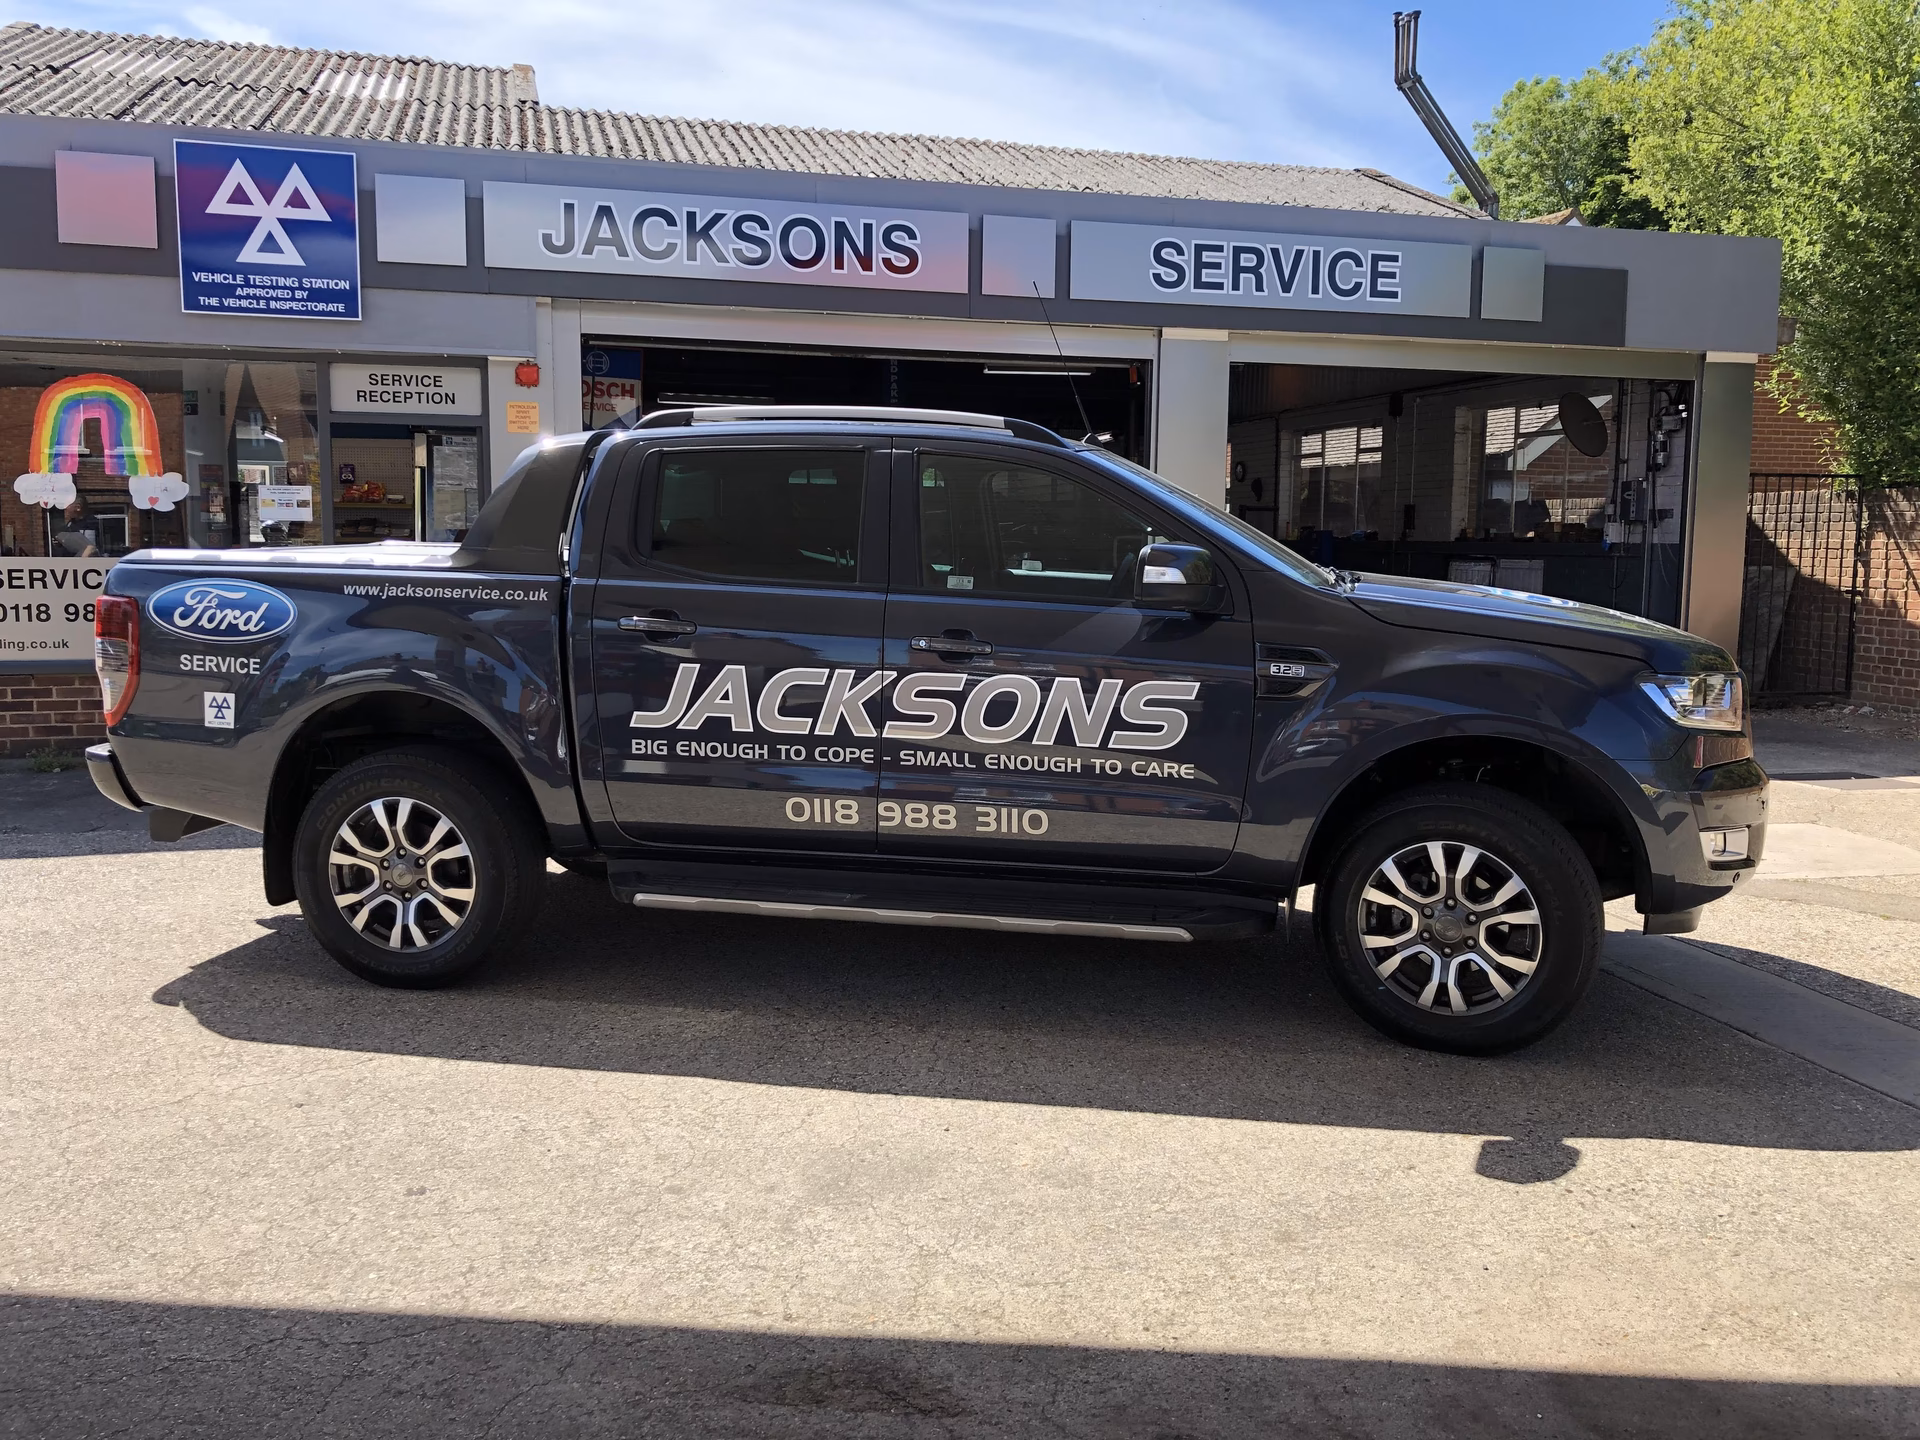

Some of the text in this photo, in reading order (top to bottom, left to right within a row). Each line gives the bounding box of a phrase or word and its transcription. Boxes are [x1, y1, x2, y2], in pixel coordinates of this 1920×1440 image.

[538, 198, 1402, 302] JACKSONS SERVICE
[192, 271, 350, 290] VEHICLE TESTING STATION
[235, 287, 308, 299] APPROVED BY
[198, 296, 346, 313] THE VEHICLE INSPECTORATE
[368, 373, 443, 388] SERVICE
[582, 380, 635, 401] OSCH
[356, 390, 456, 405] RECEPTION
[583, 402, 617, 412] ERVICE
[0, 568, 110, 590] ERVIC
[343, 583, 548, 601] www.jacksonservice.co.uk
[64, 603, 96, 623] 98
[173, 587, 269, 632] Ford
[179, 653, 261, 675] SERVICE
[629, 663, 1200, 750] JACKSONS
[631, 738, 668, 755] BIG
[676, 740, 768, 760] ENOUGH
[776, 744, 806, 761] TO
[814, 746, 875, 764] COPE
[899, 750, 976, 769] SMALL
[984, 753, 1081, 773] ENOUGH
[1090, 758, 1122, 775] TO
[1130, 761, 1195, 780] CARE
[316, 778, 444, 829] CONTINENTAL
[785, 797, 1049, 835] 0118 988 3110
